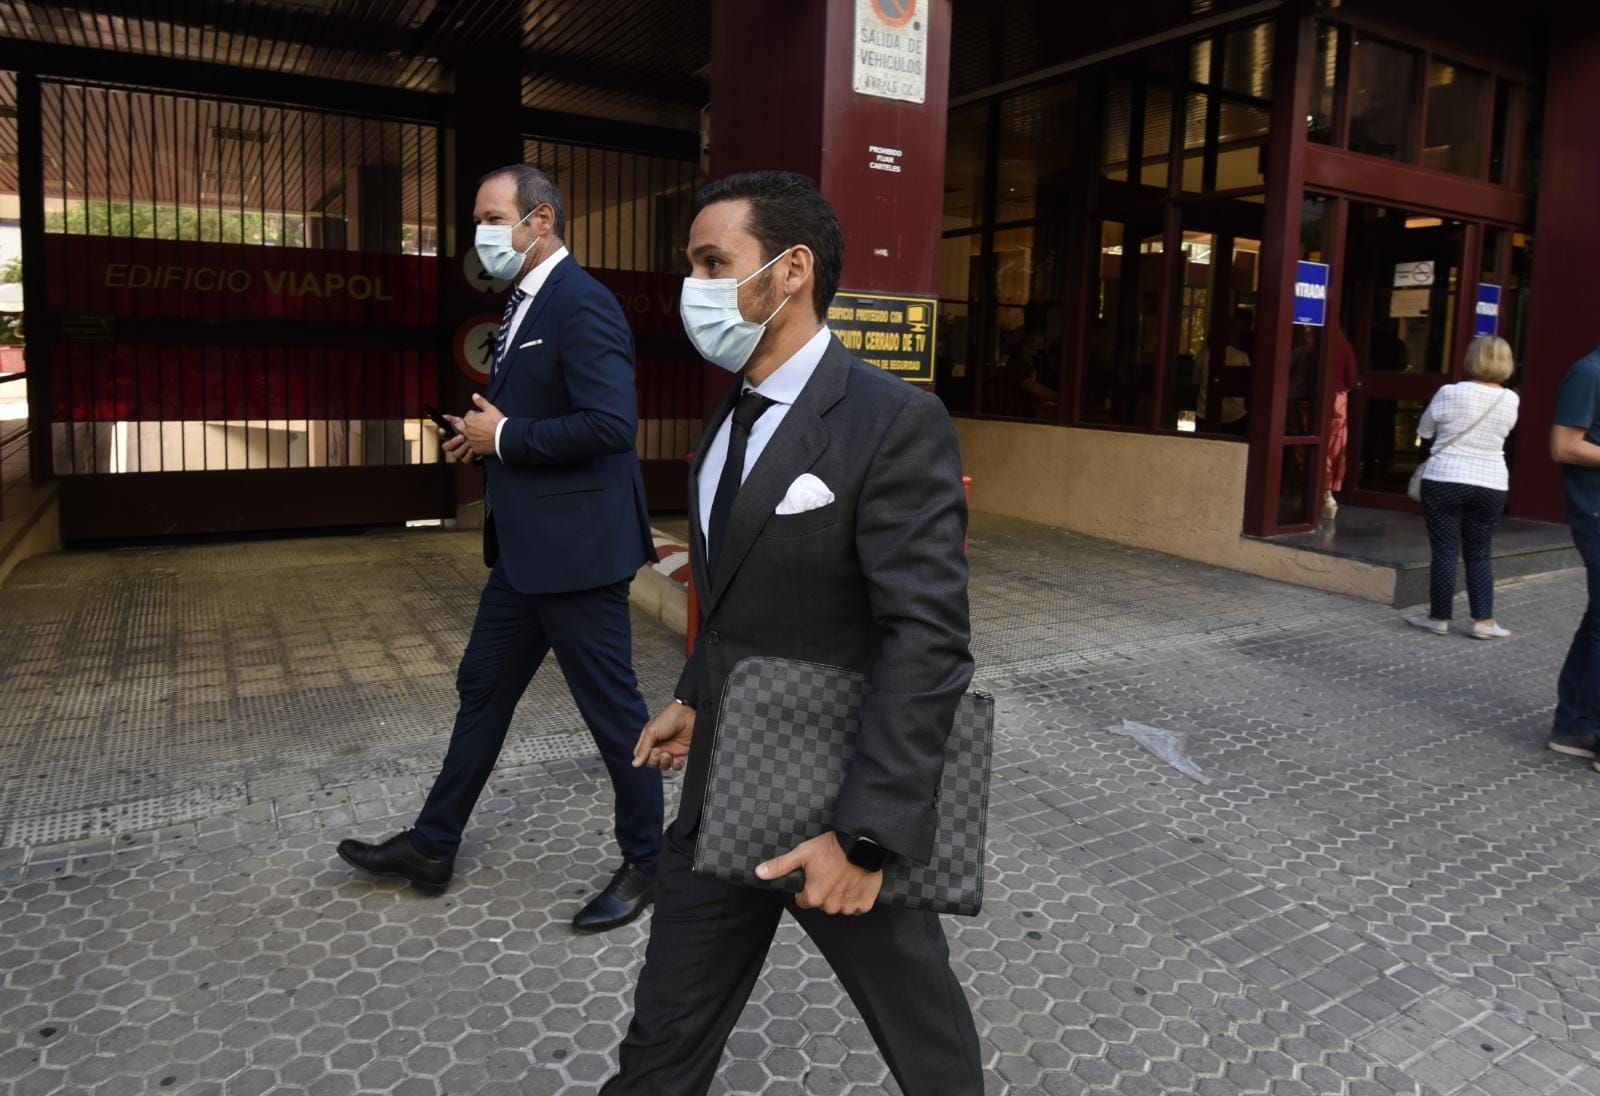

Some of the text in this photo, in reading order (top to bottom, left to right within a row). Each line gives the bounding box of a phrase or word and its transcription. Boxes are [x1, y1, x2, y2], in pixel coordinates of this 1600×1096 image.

[861, 28, 923, 54] SALIDA DE
[861, 49, 922, 75] VEHICULOS
[104, 263, 393, 302] EDIFICIO VIAPOL
[1295, 282, 1326, 300] NTRADA
[866, 331, 899, 351] CERRADO
[902, 333, 913, 352] DE
[915, 334, 926, 353] TV
